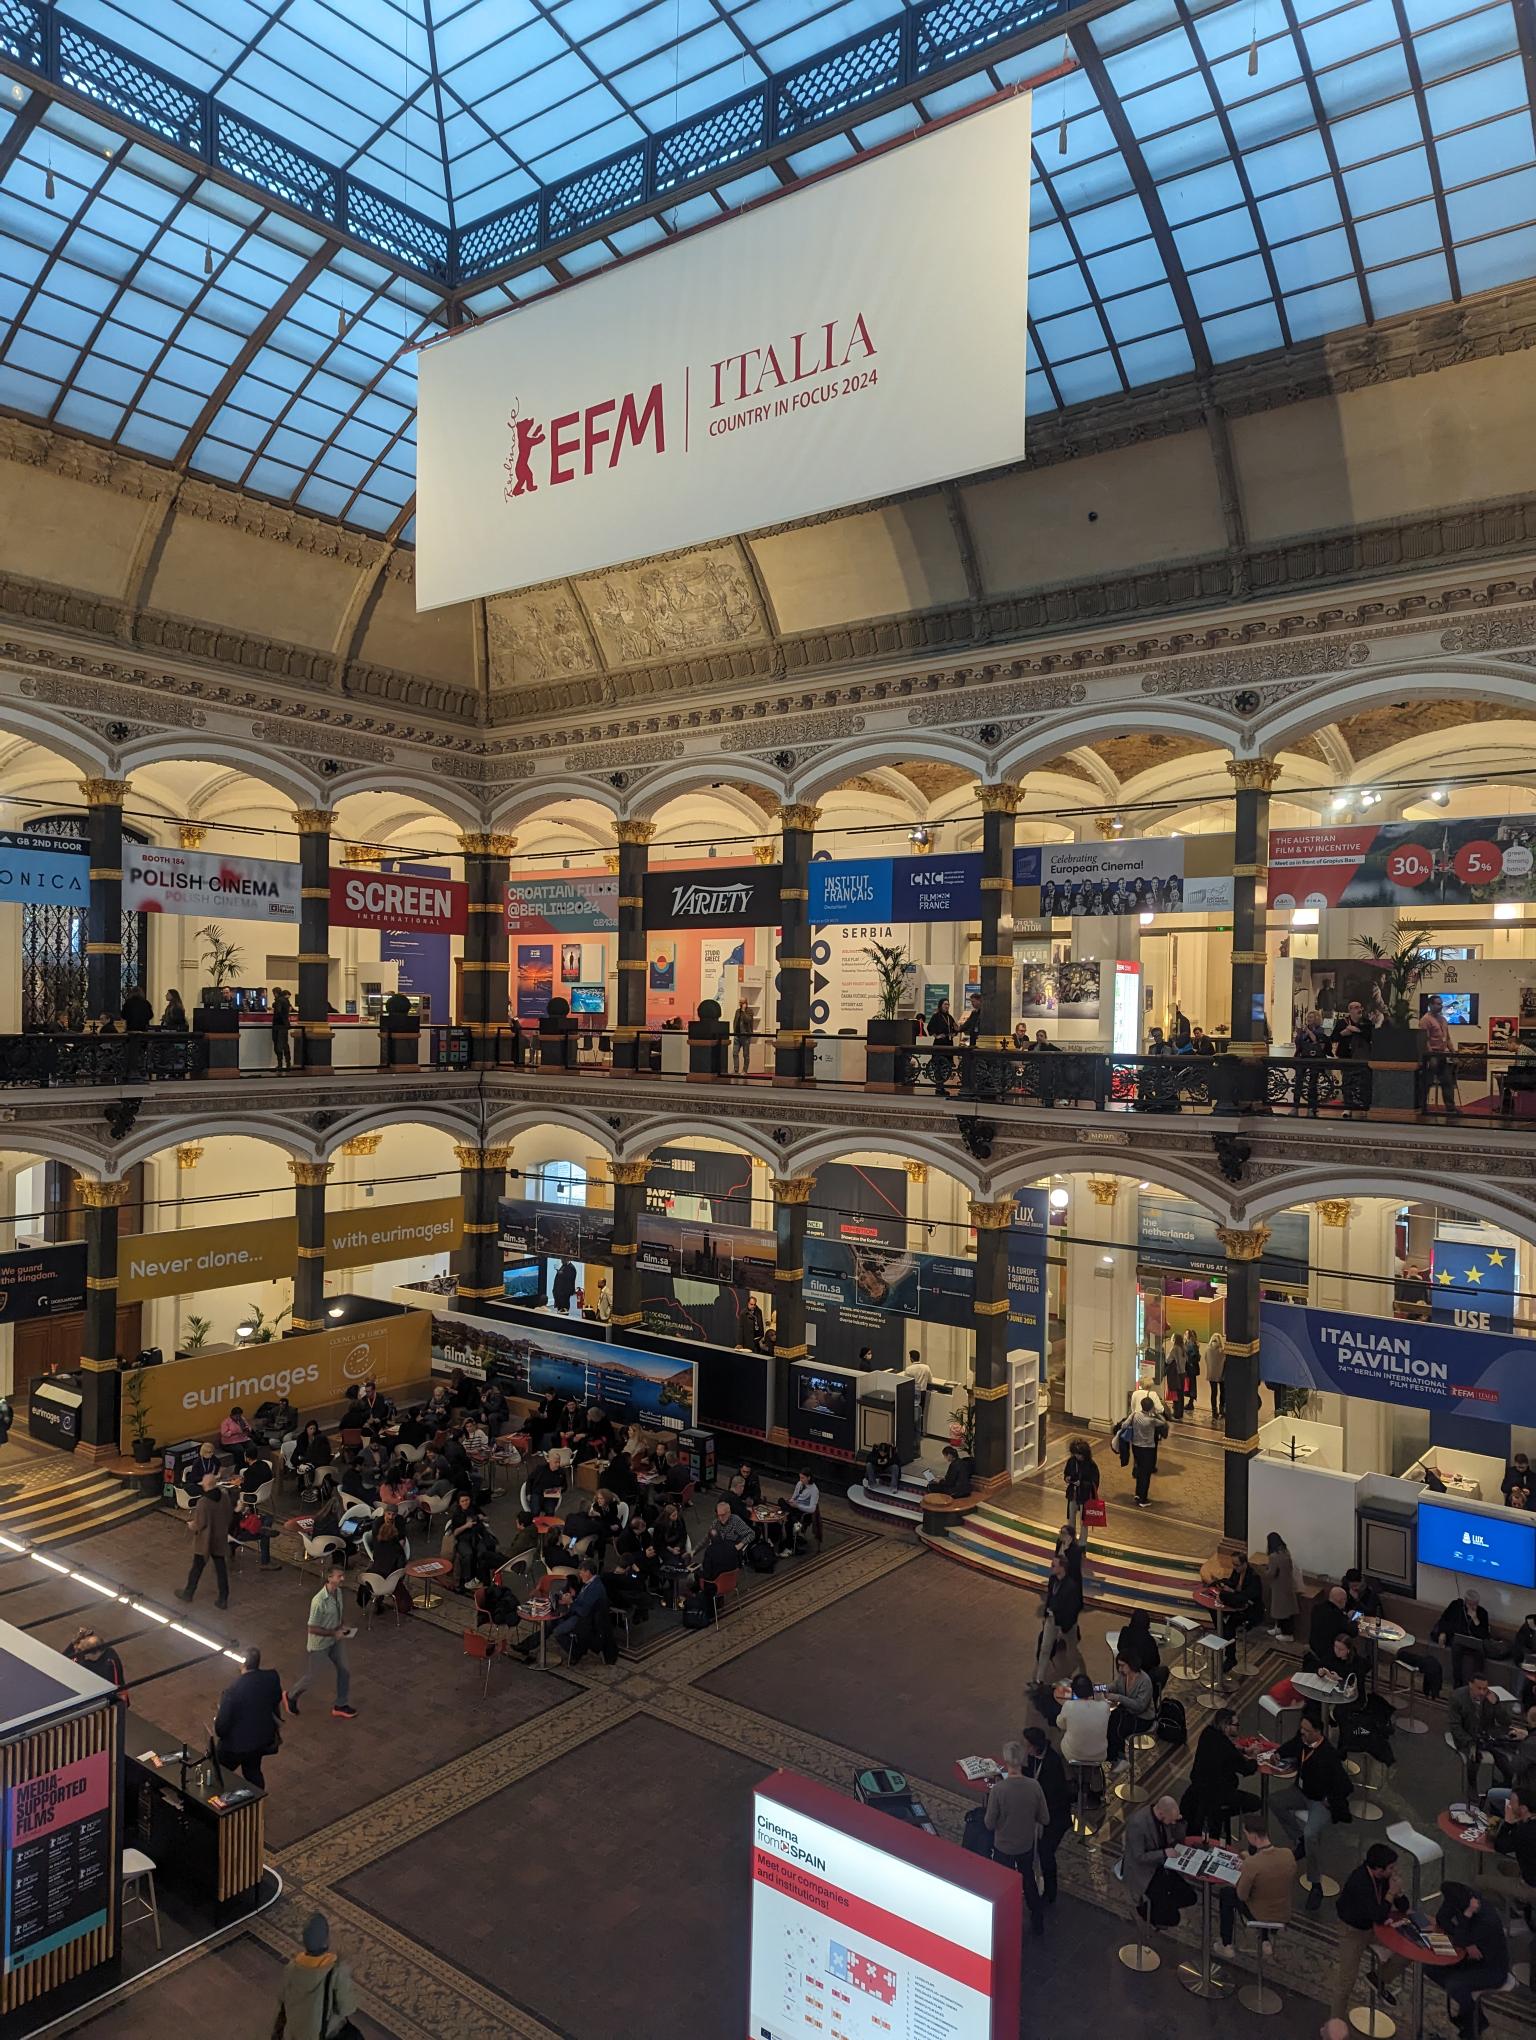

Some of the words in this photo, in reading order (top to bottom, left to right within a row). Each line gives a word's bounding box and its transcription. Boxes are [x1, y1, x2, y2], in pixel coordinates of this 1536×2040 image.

[709, 312, 878, 409] ITALIA
[709, 404, 772, 437] COUNTRY
[774, 398, 789, 417] IN
[792, 382, 838, 411] FOCUS
[842, 369, 878, 395] 2024
[550, 383, 665, 486] EFM
[16, 837, 30, 846] GB
[32, 838, 52, 848] 2ND
[54, 841, 82, 851] FLOOR
[1293, 835, 1336, 844] AUSTRIAN
[1315, 843, 1361, 853] INCENTIVE
[142, 854, 171, 864] BOOTH
[172, 856, 185, 865] 184
[1050, 853, 1098, 865] Celebrating
[1050, 864, 1099, 876] European
[1101, 860, 1144, 872] Cinema!
[1392, 856, 1429, 875] 30%
[1467, 853, 1492, 872] 5%
[130, 867, 203, 890] POLISH
[208, 876, 280, 898] CINEMA
[824, 874, 870, 890] INSTITUT
[910, 871, 945, 886] CNC
[345, 879, 452, 919] SCREEN
[508, 885, 574, 900] CROATIAN
[577, 882, 619, 897] FILMS
[671, 882, 754, 917] VARIETY
[823, 886, 874, 904] FRANÇAIS
[919, 893, 937, 902] FILM
[508, 901, 601, 919] @BERLIN2024
[919, 900, 950, 910] FRANCE
[357, 913, 440, 926] INTERNATIONAL
[842, 926, 893, 939] SERBIA
[1014, 1206, 1034, 1222] LUX
[1143, 1217, 1157, 1227] the
[332, 1232, 368, 1251] with
[370, 1217, 455, 1246] eurimages!
[1142, 1228, 1195, 1241] netherlands
[130, 1258, 191, 1279] Never
[196, 1249, 263, 1270] alone...
[642, 1253, 669, 1265] film.sa
[1190, 1261, 1206, 1269] VISIT
[1, 1267, 15, 1276] We
[17, 1263, 43, 1275] guard
[1, 1276, 16, 1285] the
[17, 1271, 58, 1283] kingdom.
[1016, 1266, 1037, 1277] EUROPE
[810, 1279, 841, 1294] film.sa
[1011, 1274, 1040, 1286] SUPPORTS
[1026, 1284, 1040, 1294] FILM
[1454, 1308, 1491, 1331] USE
[1320, 1327, 1411, 1356] ITALIAN
[443, 1345, 482, 1367] film.sa
[1338, 1347, 1448, 1380] PAVILION
[182, 1362, 320, 1410] eurimages
[1354, 1368, 1382, 1379] BERLIN
[1383, 1373, 1447, 1389] INTERNATIONAL
[1389, 1380, 1408, 1390] FILM
[1409, 1383, 1447, 1396] FESTIVAL
[1457, 1389, 1475, 1399] EFM
[31, 1406, 61, 1425] eurimages
[1472, 1534, 1484, 1544] LUX
[16, 1774, 63, 1805] MEDIA-
[16, 1777, 87, 1820] SUPPORTED
[16, 1806, 55, 1837] FILMS
[757, 1815, 799, 1844] Cinema
[757, 1828, 780, 1849] from
[790, 1845, 826, 1872] SPAIN
[757, 1854, 780, 1873] Meet
[780, 1867, 797, 1880] our
[797, 1876, 849, 1907] companies
[757, 1867, 774, 1881] and
[774, 1873, 829, 1910] institutions!
